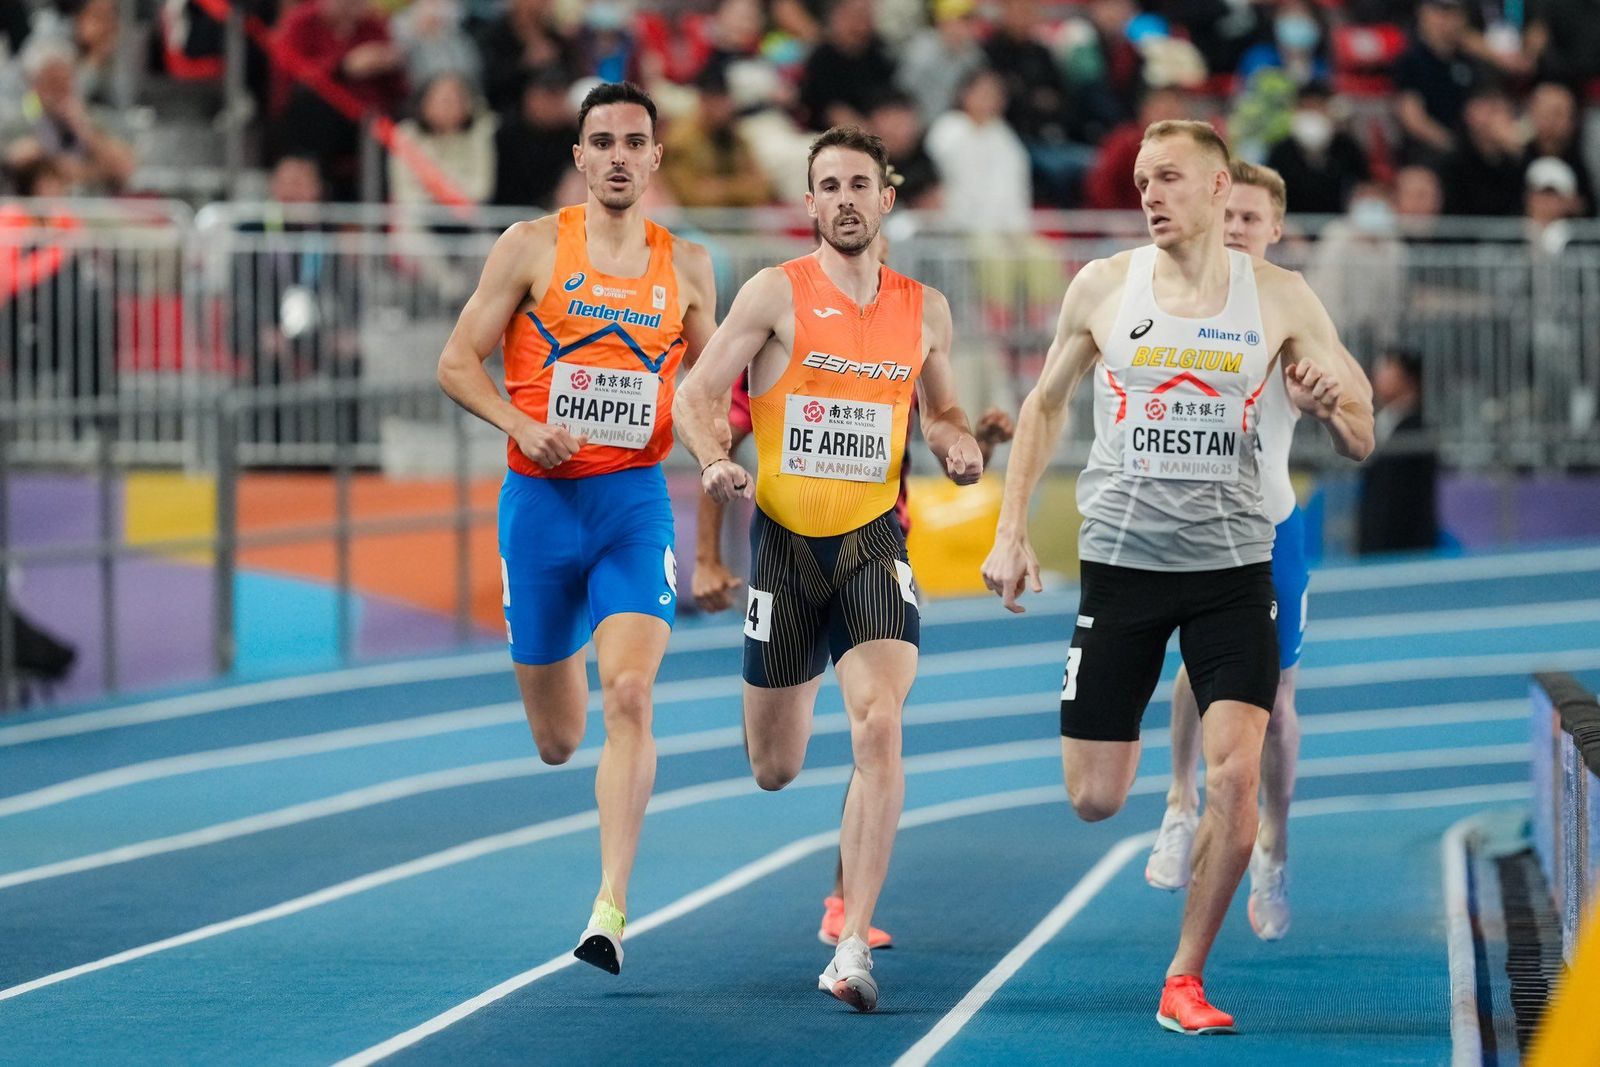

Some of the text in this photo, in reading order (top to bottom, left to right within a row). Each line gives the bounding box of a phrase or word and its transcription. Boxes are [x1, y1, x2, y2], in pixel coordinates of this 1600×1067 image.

[567, 299, 662, 329] Nederland
[1198, 328, 1241, 342] Allianz
[802, 351, 912, 382] ESPAÑA
[1131, 346, 1244, 373] BELGIUM
[595, 373, 643, 390] 南京银行
[555, 394, 652, 427] CHAPPLE
[829, 404, 877, 423] 南京银行
[1171, 401, 1227, 418] 南京银行
[789, 427, 887, 460] DE ARRIBA
[1132, 427, 1236, 456] CRESTAN
[748, 597, 760, 632] 4
